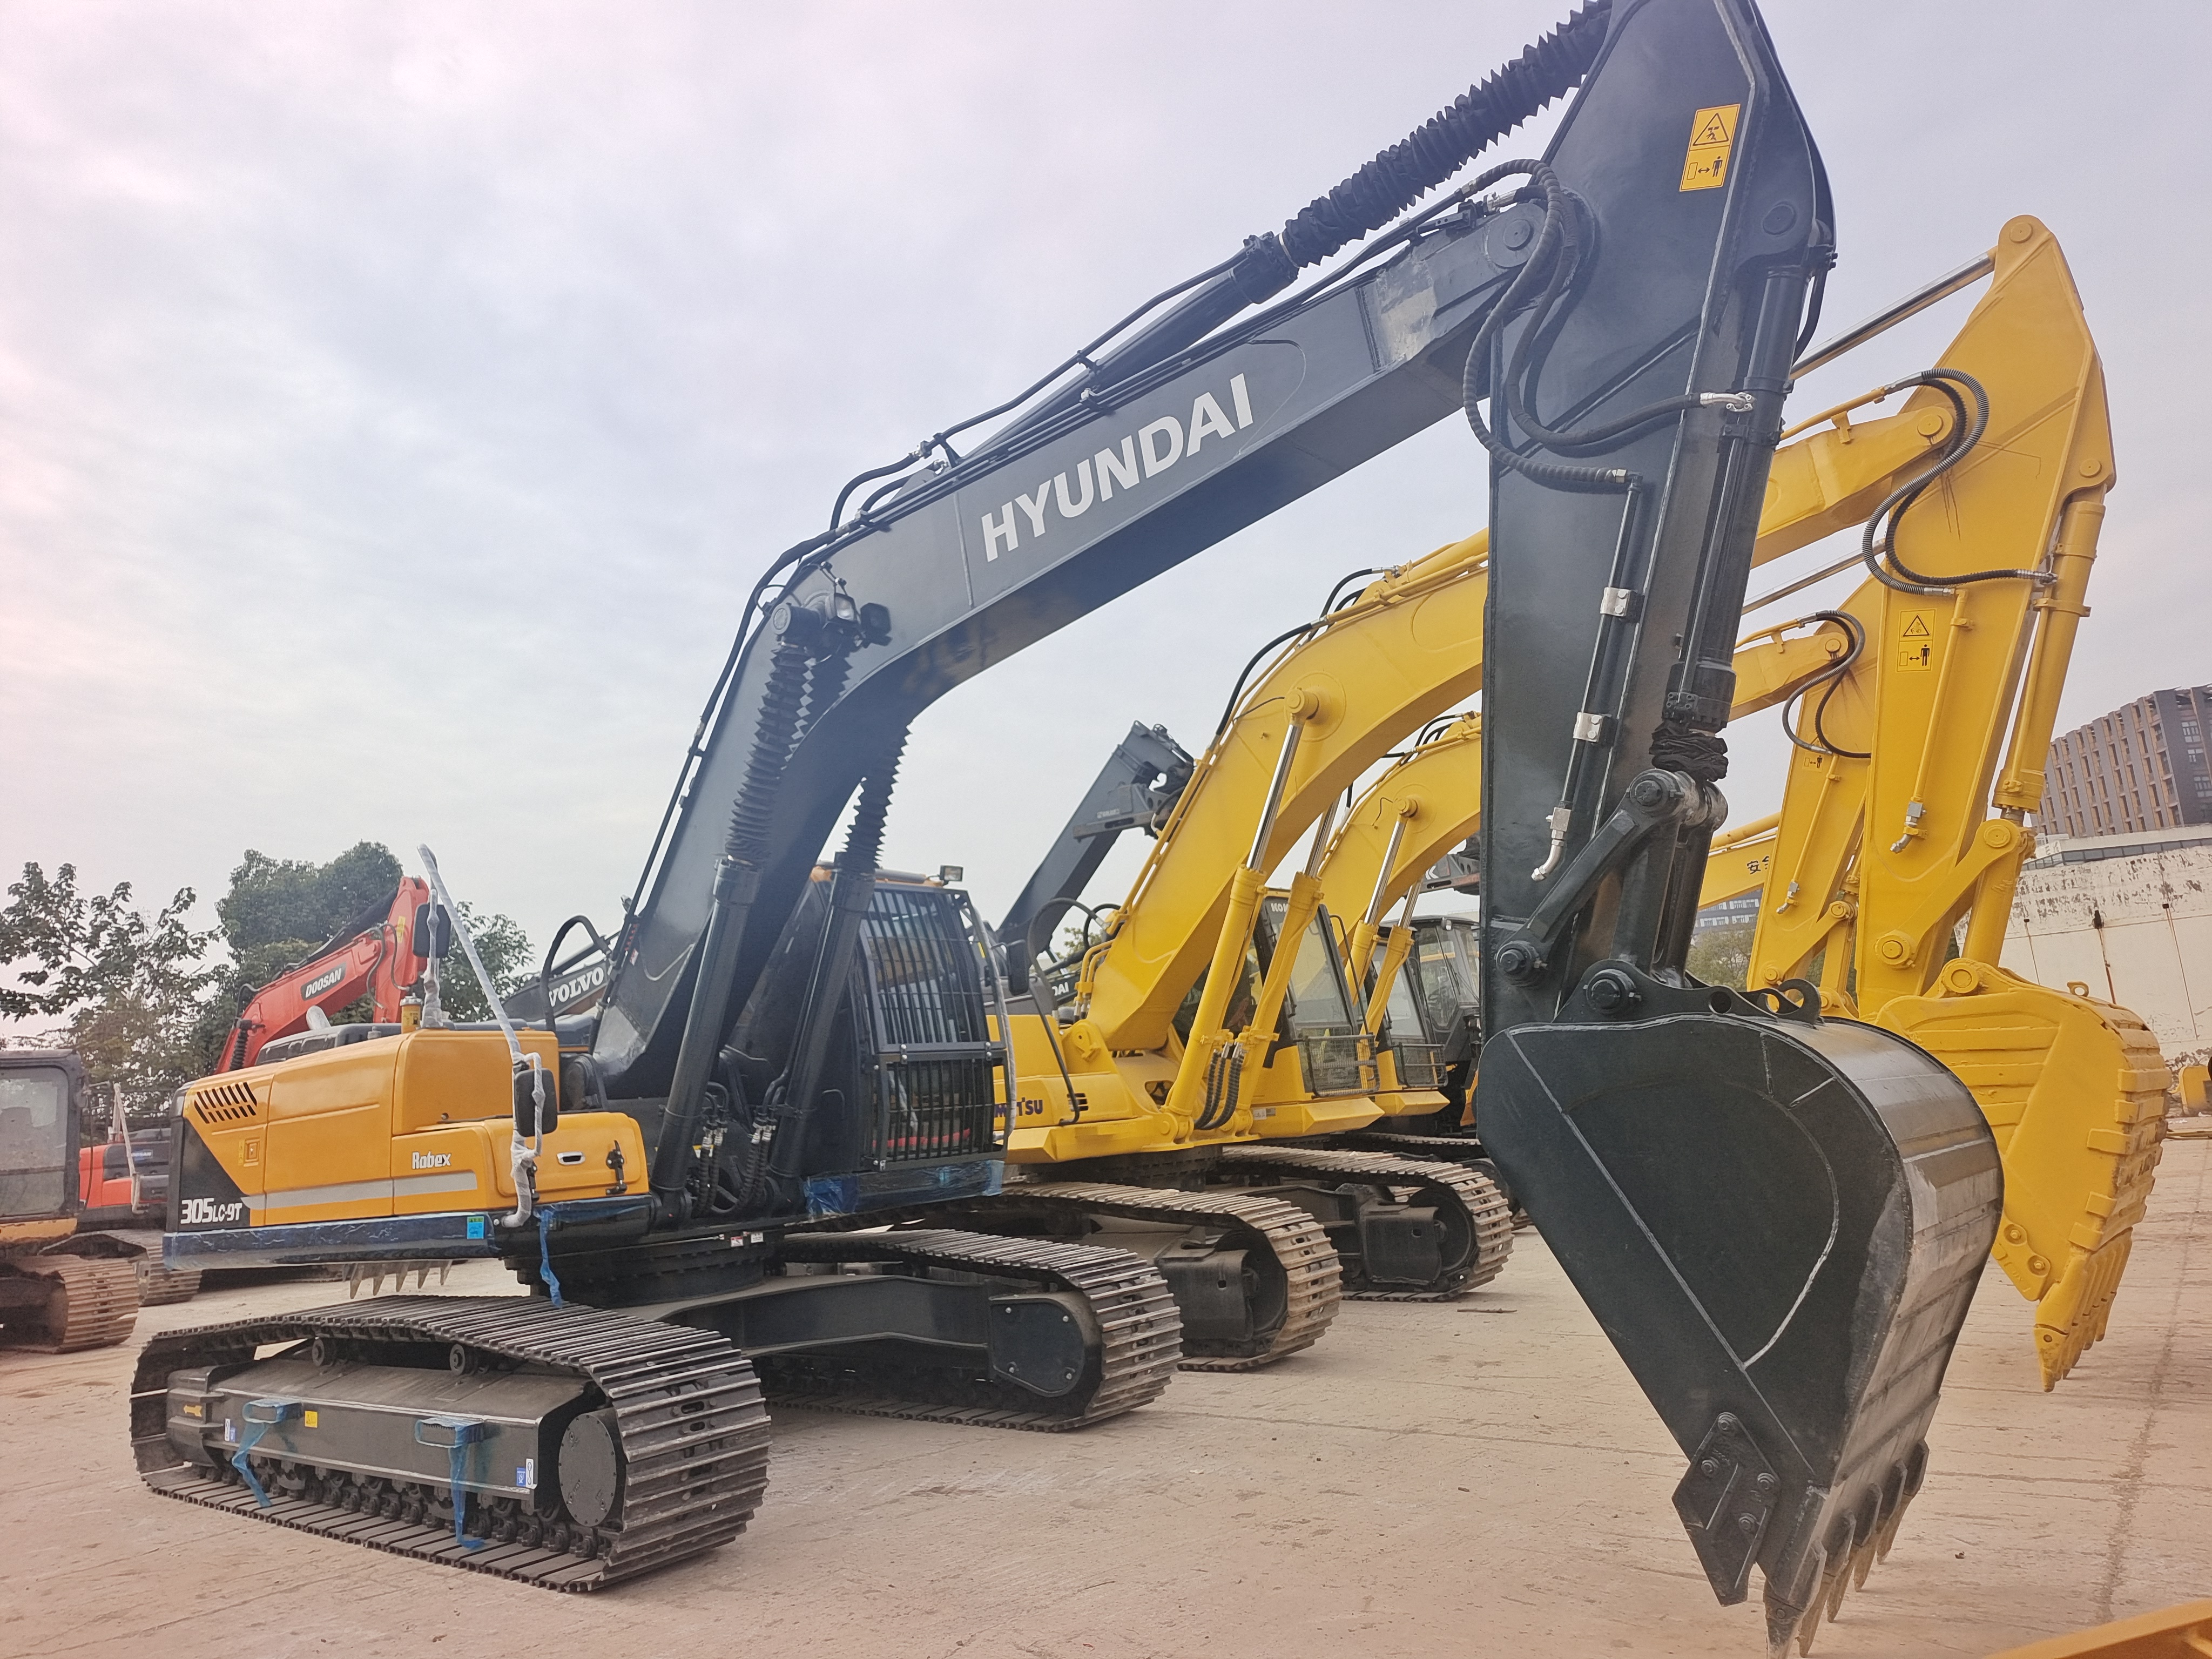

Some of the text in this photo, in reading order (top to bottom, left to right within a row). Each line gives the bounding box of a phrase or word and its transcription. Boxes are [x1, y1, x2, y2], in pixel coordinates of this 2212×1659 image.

[981, 373, 1253, 562] HYUNDAI
[306, 967, 341, 998] DOOSAN
[549, 967, 604, 1007] VOLVO
[413, 1151, 451, 1169] Robex
